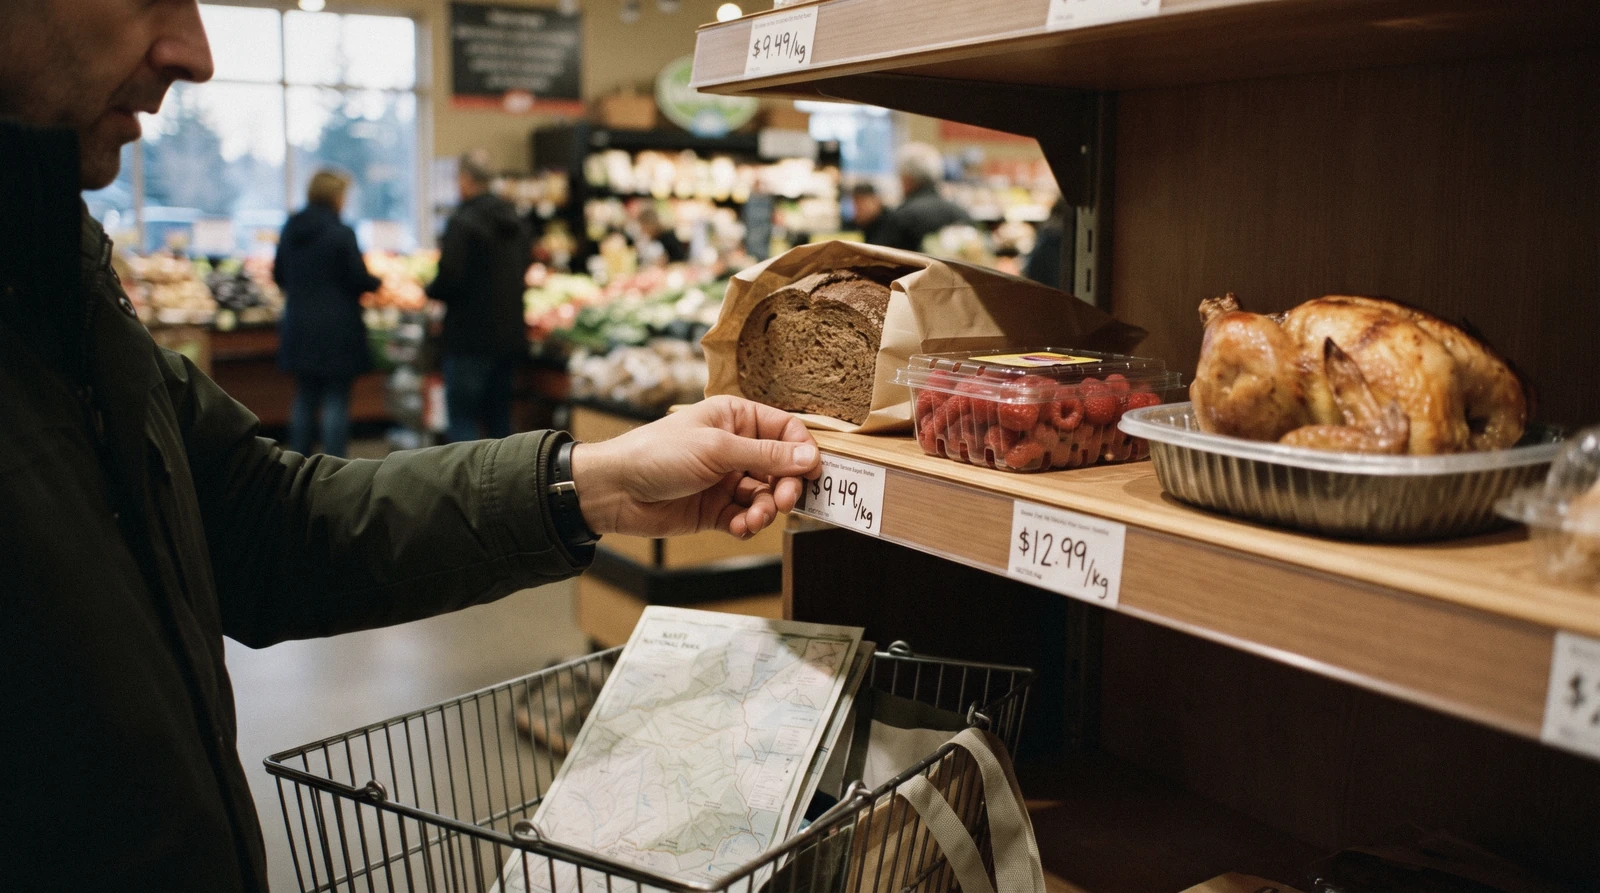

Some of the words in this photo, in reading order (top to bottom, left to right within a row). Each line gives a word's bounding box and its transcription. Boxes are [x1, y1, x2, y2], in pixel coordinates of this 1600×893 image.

[752, 31, 806, 64] $9.49/kg
[811, 475, 873, 530] $9.49/kg
[1018, 527, 1109, 600] $12.99/kg
